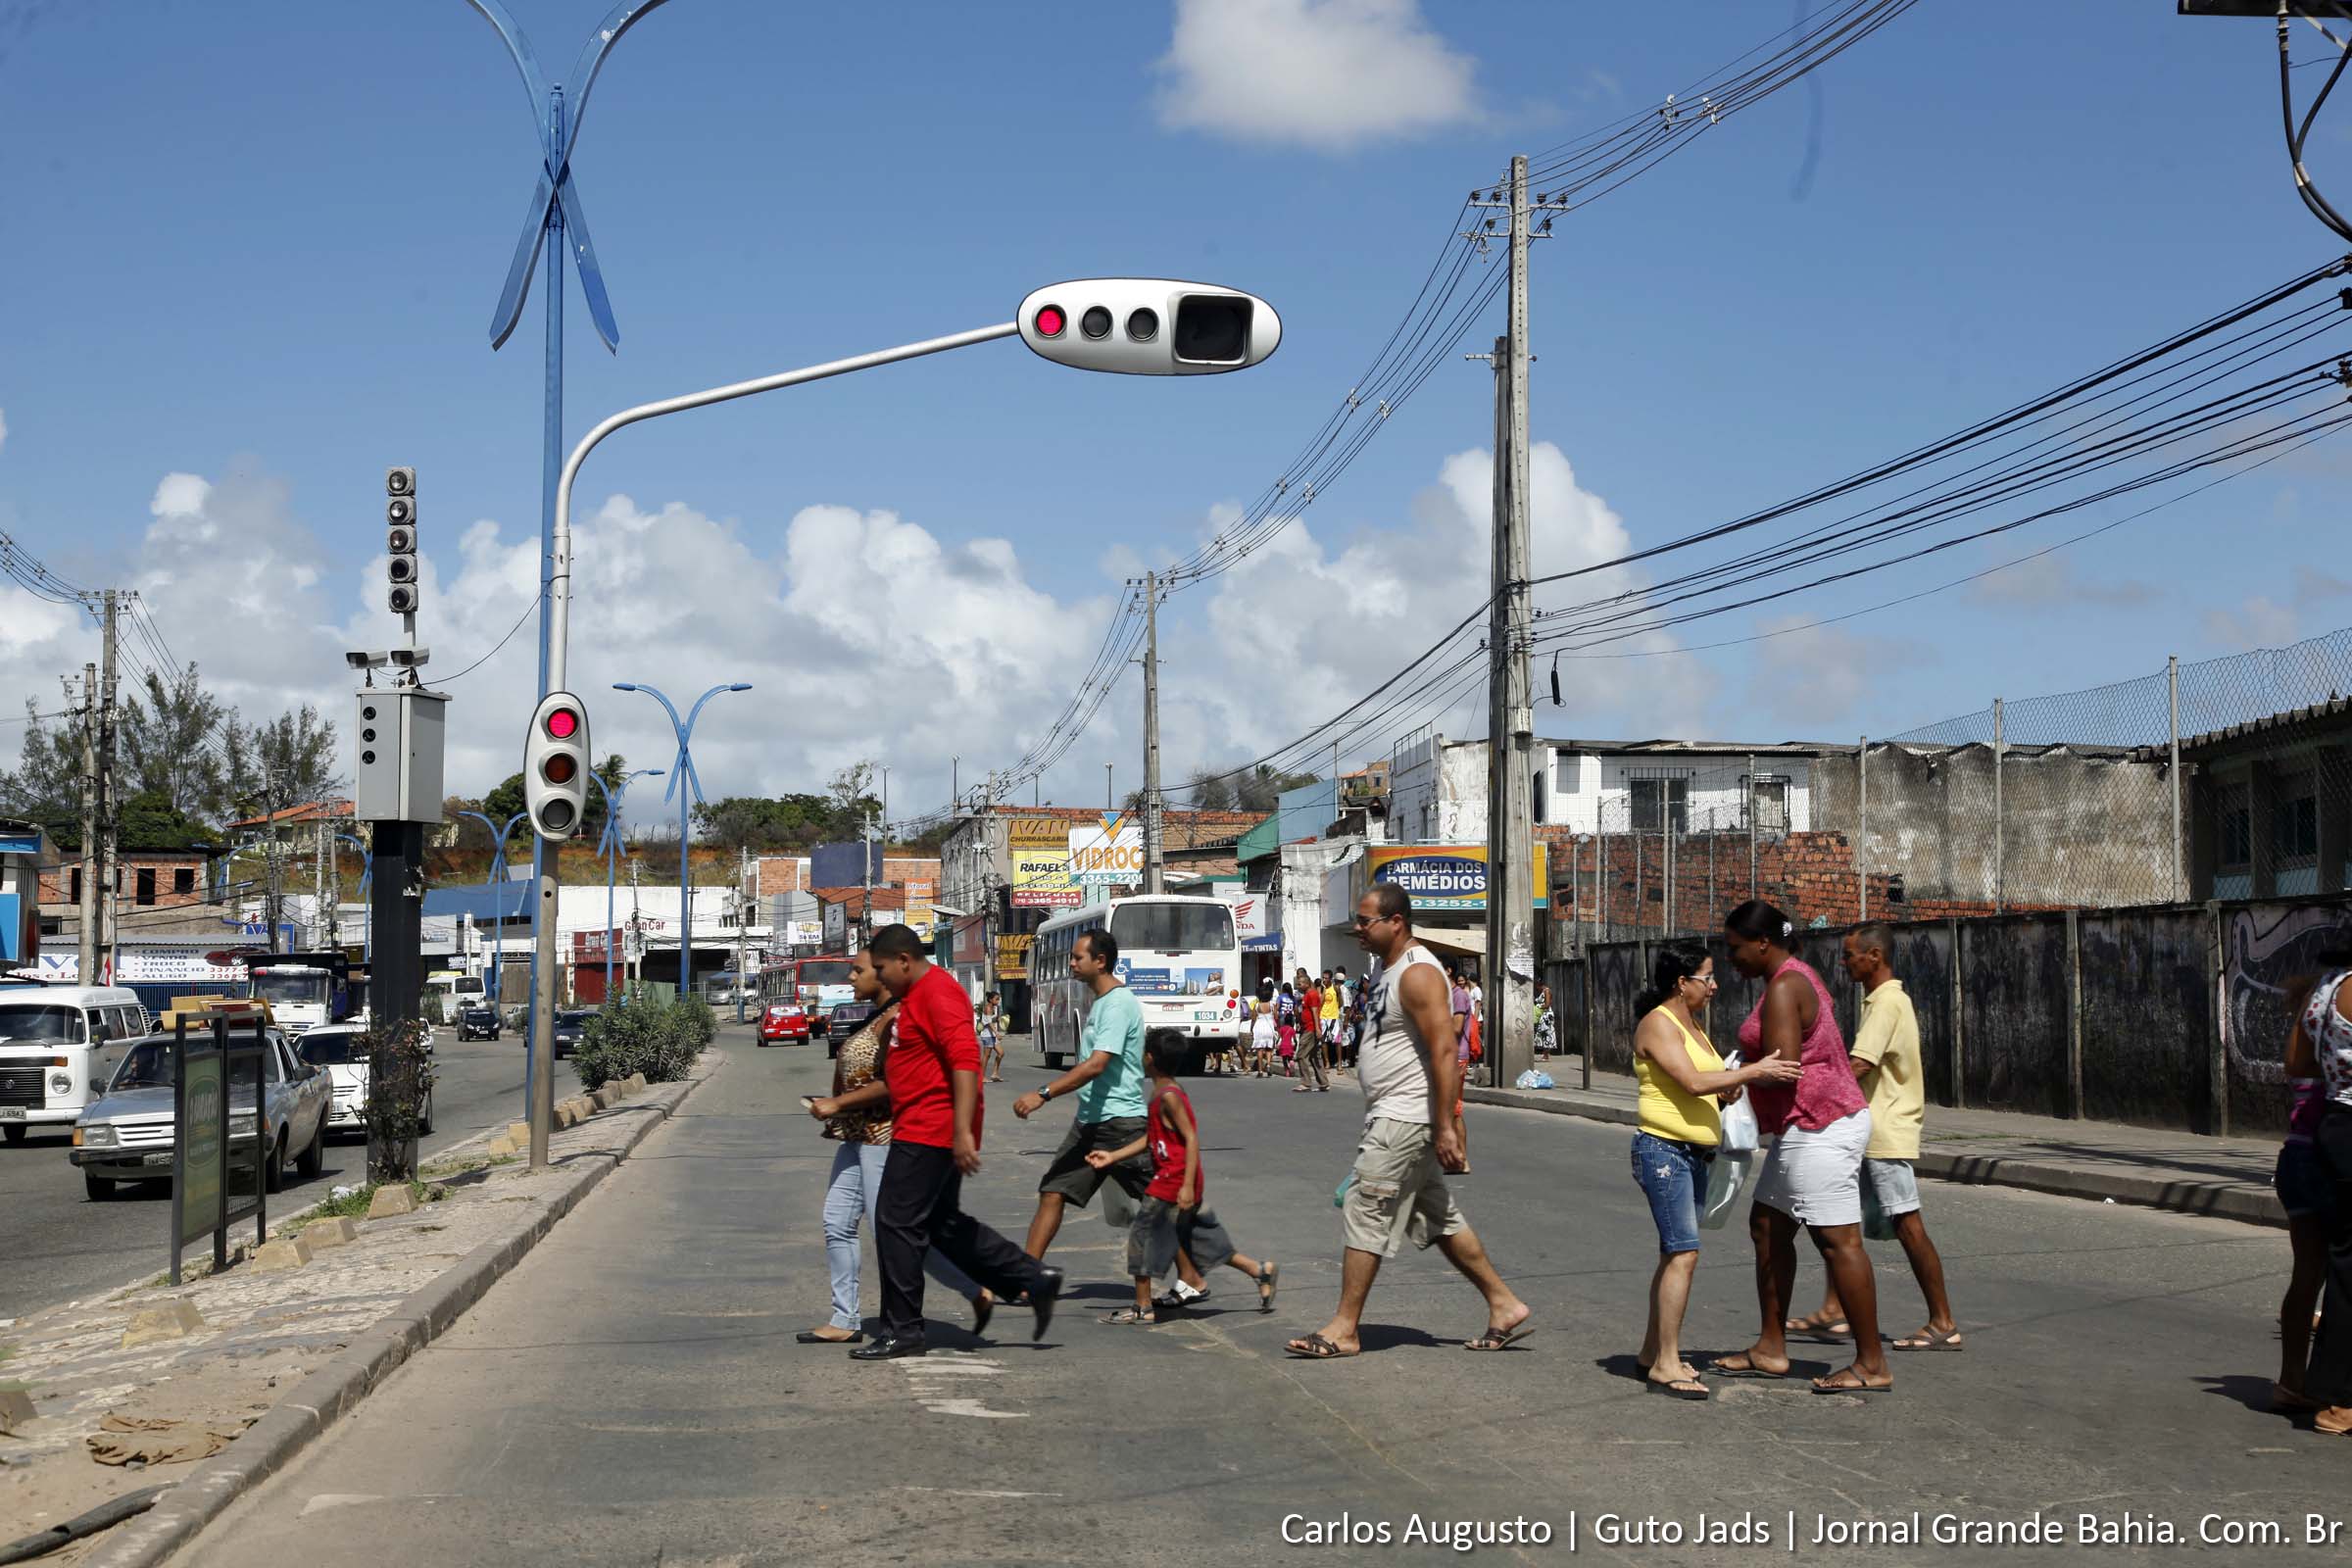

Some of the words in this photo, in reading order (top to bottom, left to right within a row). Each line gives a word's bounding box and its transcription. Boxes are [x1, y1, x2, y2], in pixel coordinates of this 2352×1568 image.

[1010, 820, 1068, 834] IVAN
[1071, 846, 1146, 871] VIDROC
[1020, 862, 1061, 872] RAFAEL
[1387, 859, 1451, 874] FARMÁCIA
[1455, 861, 1483, 873] DOS
[649, 920, 666, 931] Car
[1198, 1011, 1214, 1020] 1034
